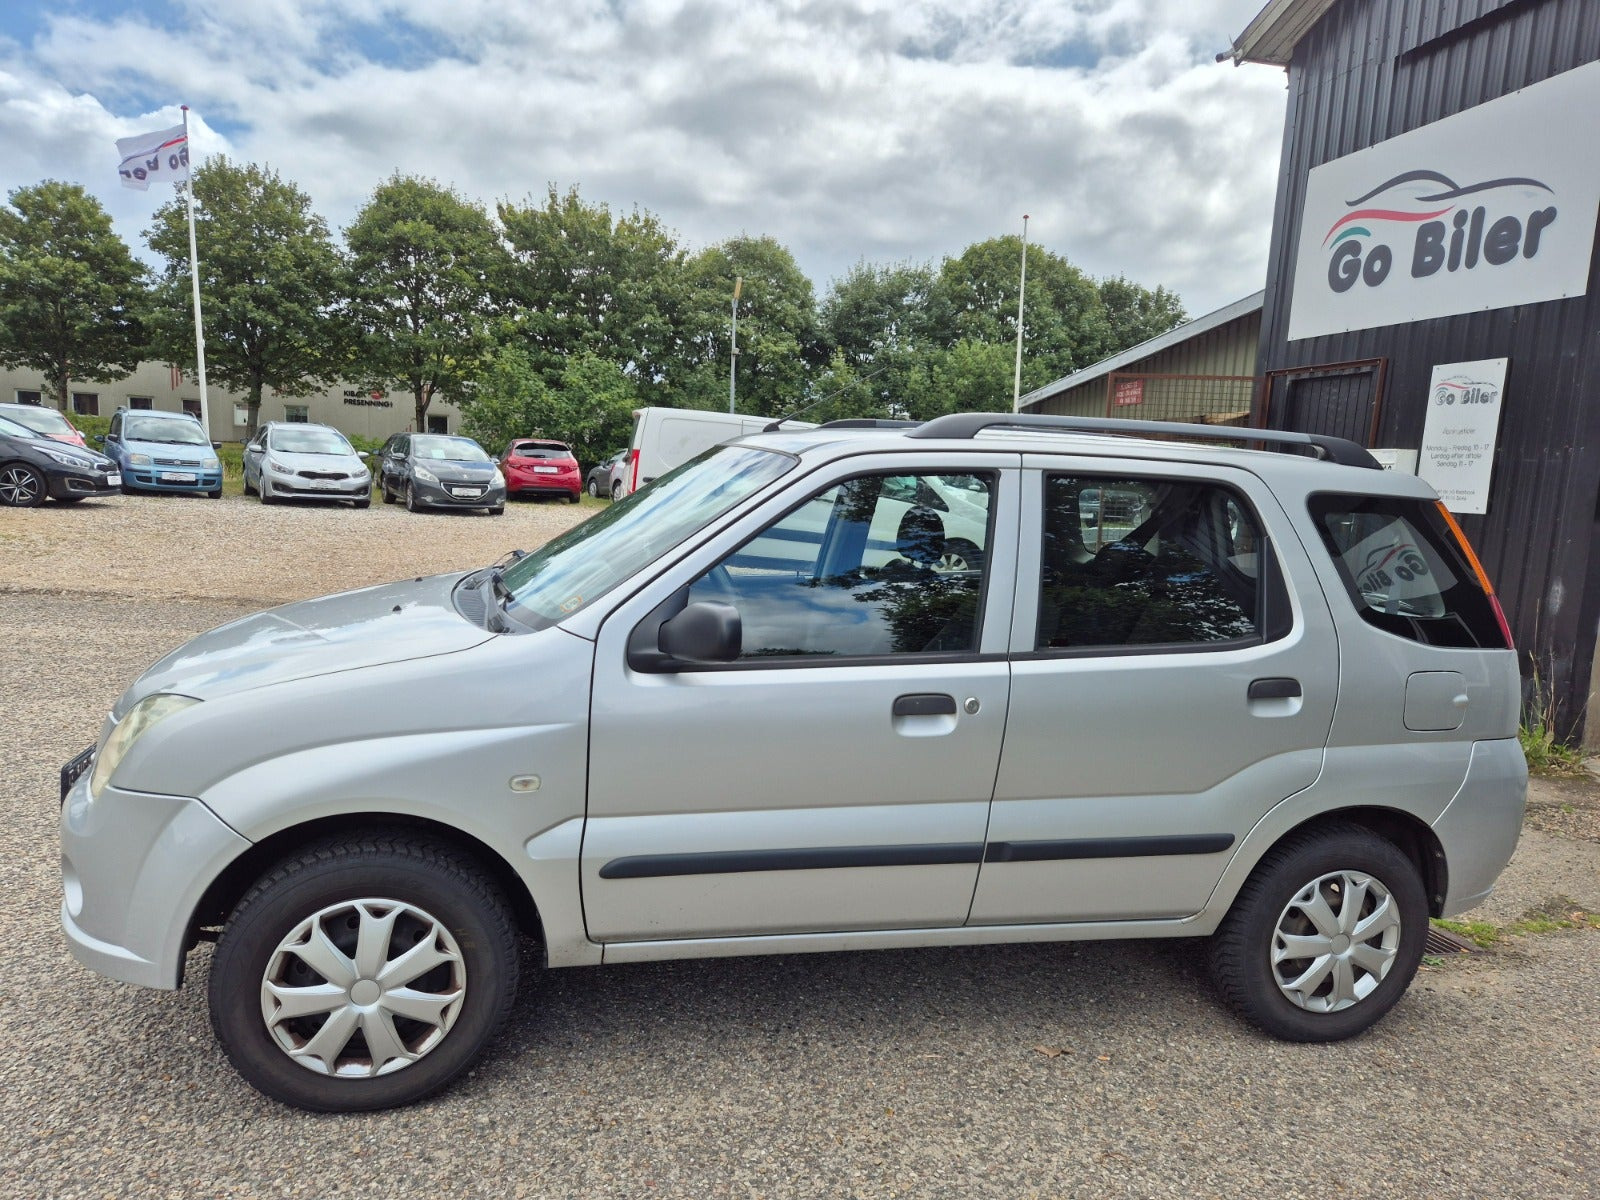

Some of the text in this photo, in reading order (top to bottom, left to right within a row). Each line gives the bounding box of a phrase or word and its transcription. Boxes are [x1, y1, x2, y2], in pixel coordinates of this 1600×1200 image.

[1328, 206, 1557, 293] Go Biler
[1435, 388, 1498, 406] Go Biler
